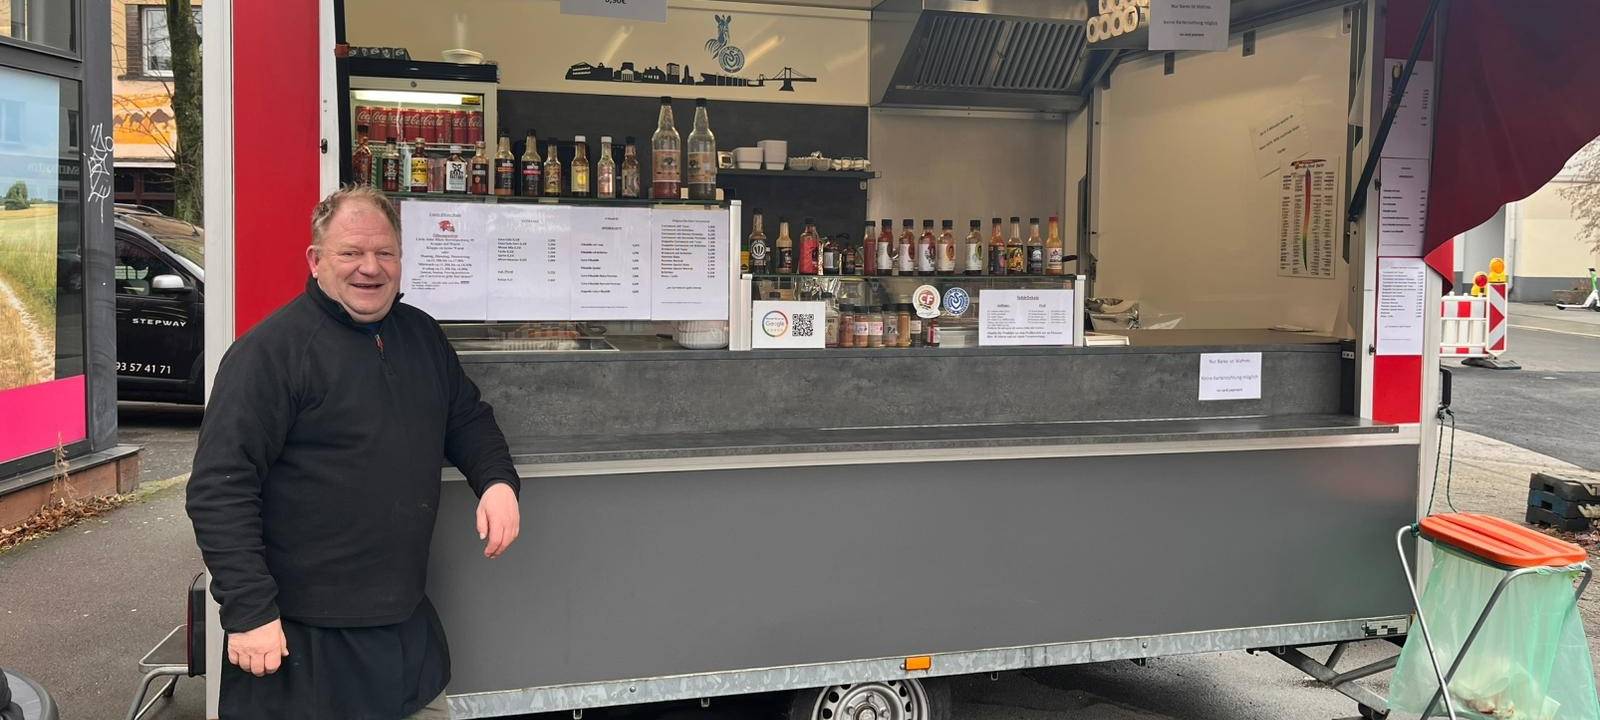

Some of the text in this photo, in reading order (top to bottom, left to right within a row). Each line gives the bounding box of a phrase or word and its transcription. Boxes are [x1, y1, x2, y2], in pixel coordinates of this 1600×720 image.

[132, 318, 187, 327] STEPWAY
[129, 363, 142, 372] 57
[144, 364, 156, 373] 41
[160, 365, 171, 374] 71
